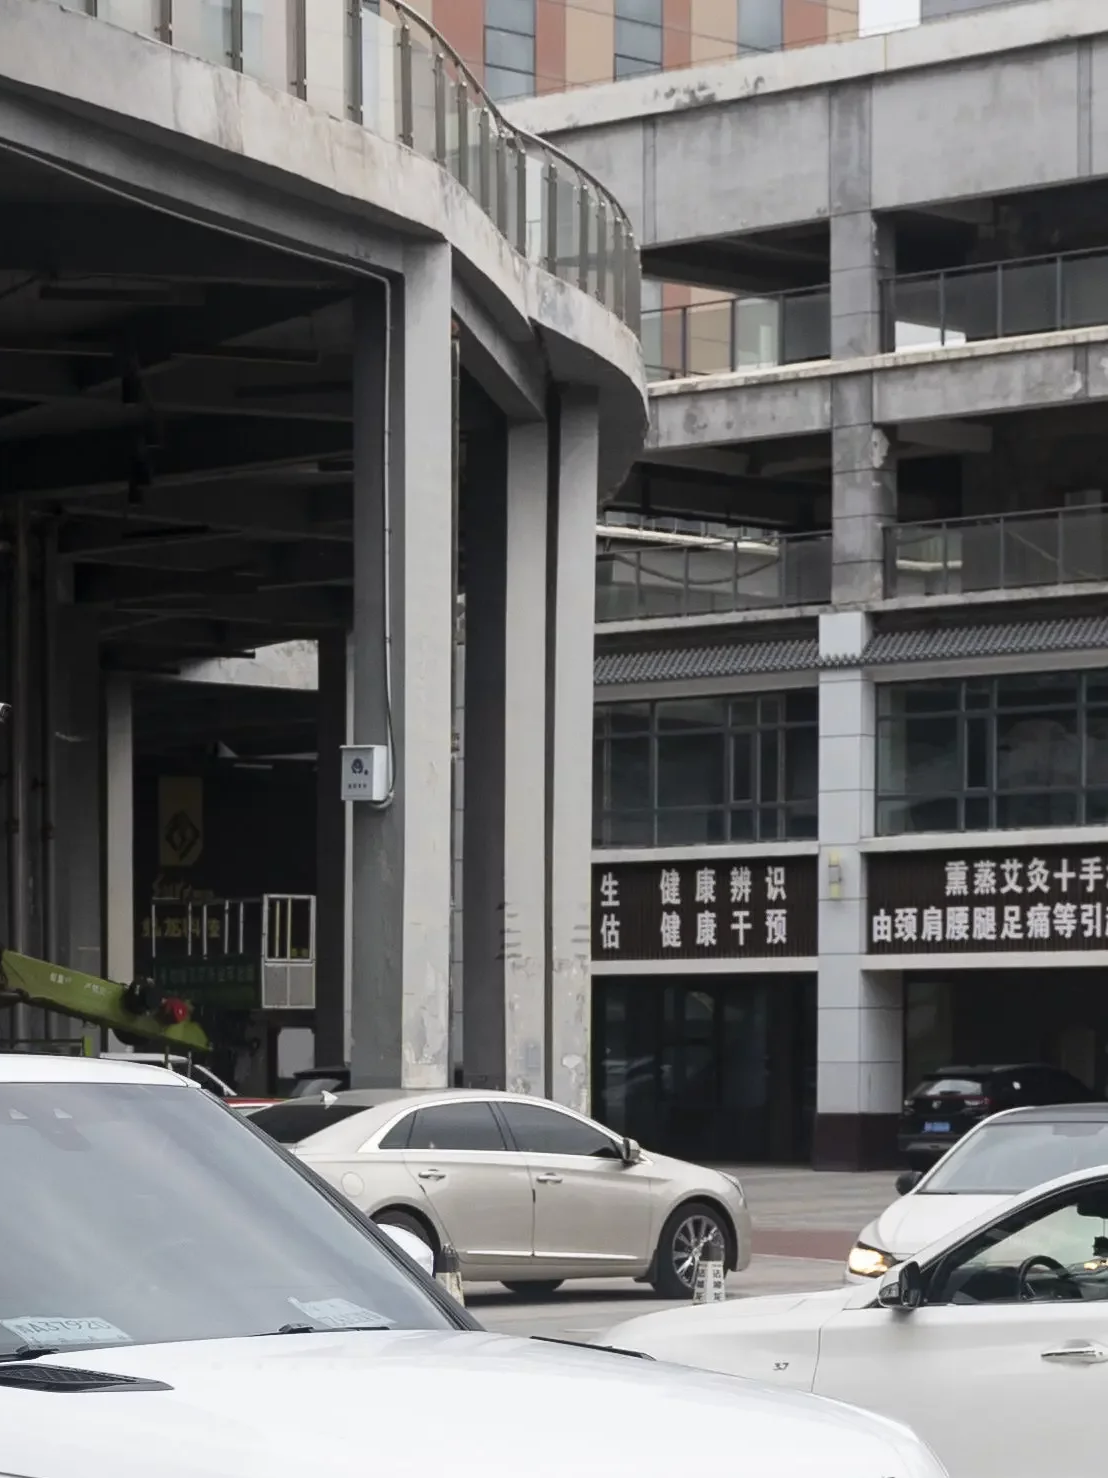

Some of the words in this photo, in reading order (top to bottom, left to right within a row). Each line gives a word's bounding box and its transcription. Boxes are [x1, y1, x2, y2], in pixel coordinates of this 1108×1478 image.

[600, 873, 620, 907] 生
[659, 866, 787, 905] 健康辨识
[945, 856, 1108, 897] 熏蒸艾灸十手
[600, 913, 620, 949] 估
[660, 909, 788, 948] 健康干预
[872, 902, 1108, 943] 由颈肩腰腿足痛等引
